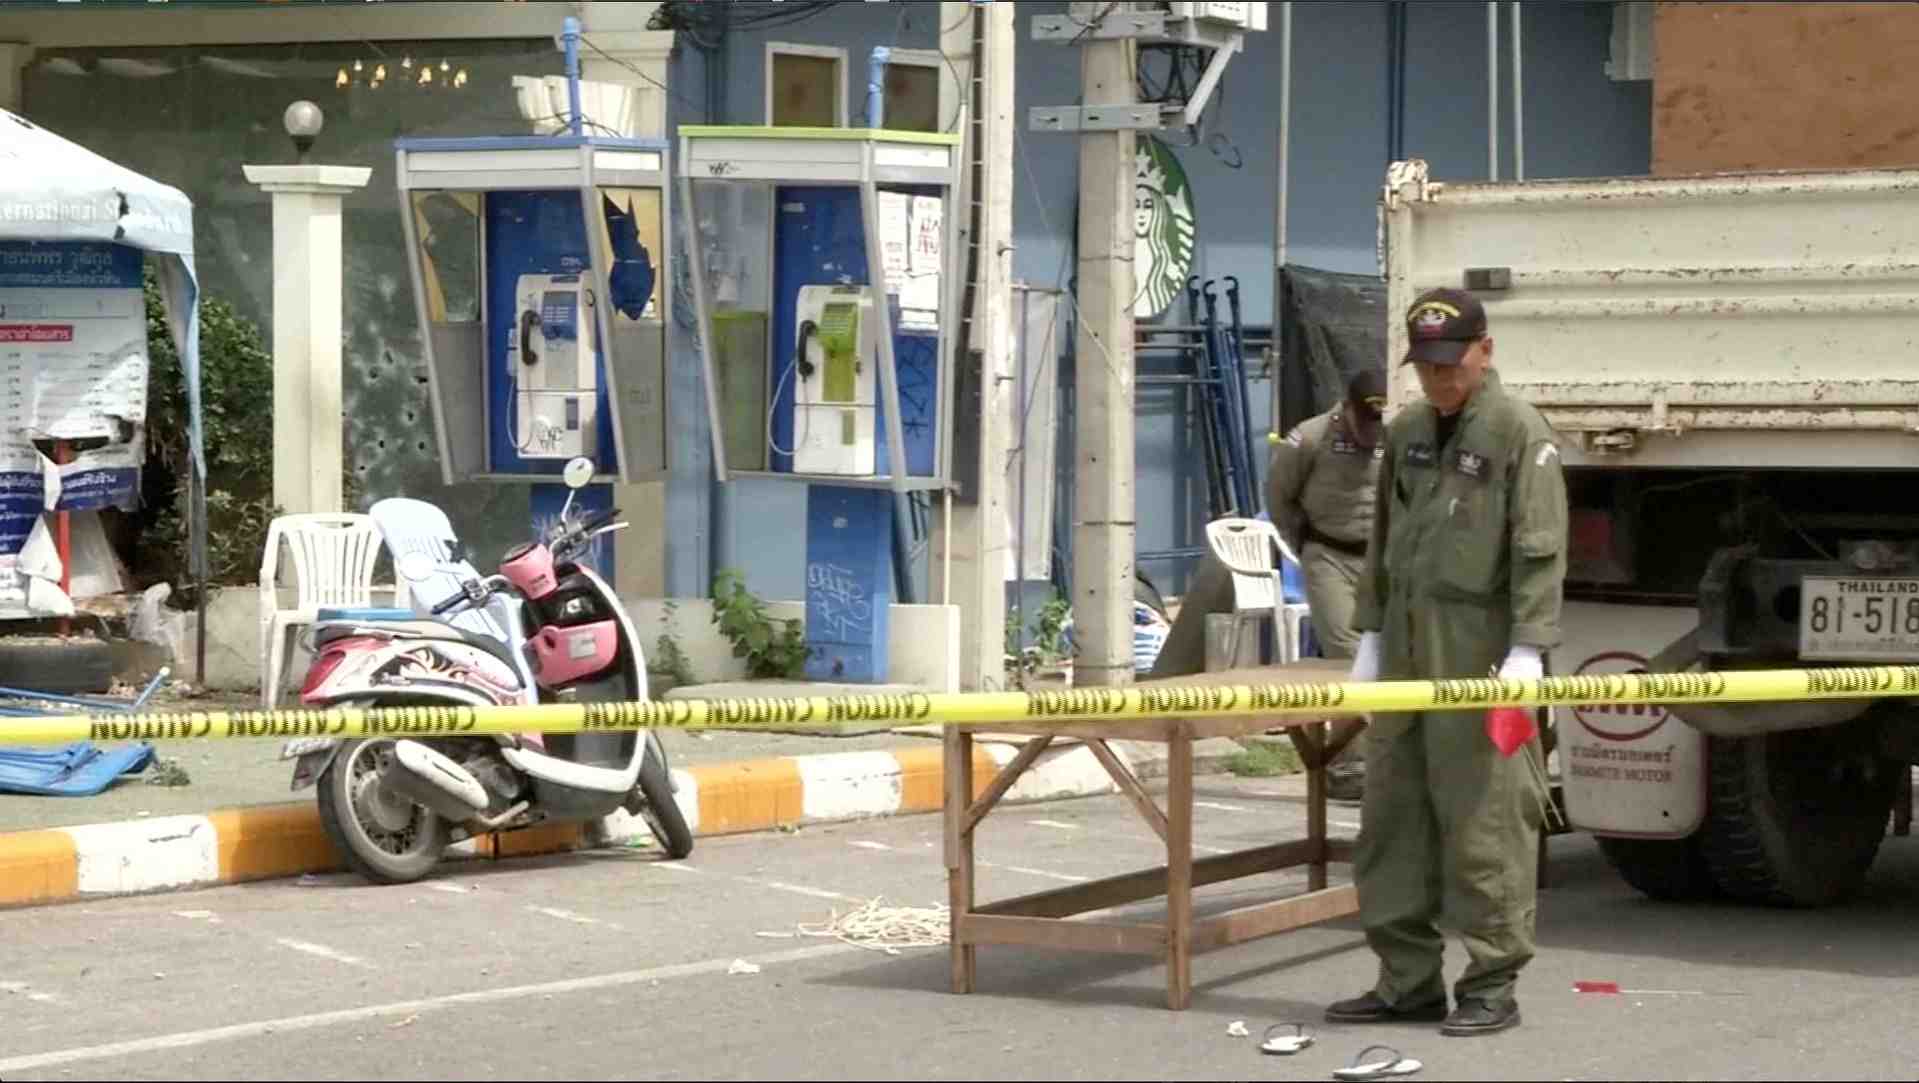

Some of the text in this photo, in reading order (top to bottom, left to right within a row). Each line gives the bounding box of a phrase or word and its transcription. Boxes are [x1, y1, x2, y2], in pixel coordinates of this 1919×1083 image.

[1838, 581, 1918, 593] THAILAND
[90, 711, 211, 740] CAUTION
[226, 709, 347, 737] CAUTION
[361, 705, 476, 732] CAUTION
[584, 700, 691, 727] CAUTION
[706, 698, 813, 723] CAUTION
[827, 694, 930, 720] CAUTION
[1027, 689, 1126, 715] CAUTION
[1139, 685, 1237, 712] CAUTION
[1250, 681, 1345, 708] CAUTION
[1433, 679, 1524, 704] CAUTION
[1537, 675, 1627, 700] CAUTION
[1639, 671, 1726, 697] CAUTION
[1807, 667, 1893, 692] CAUTION
